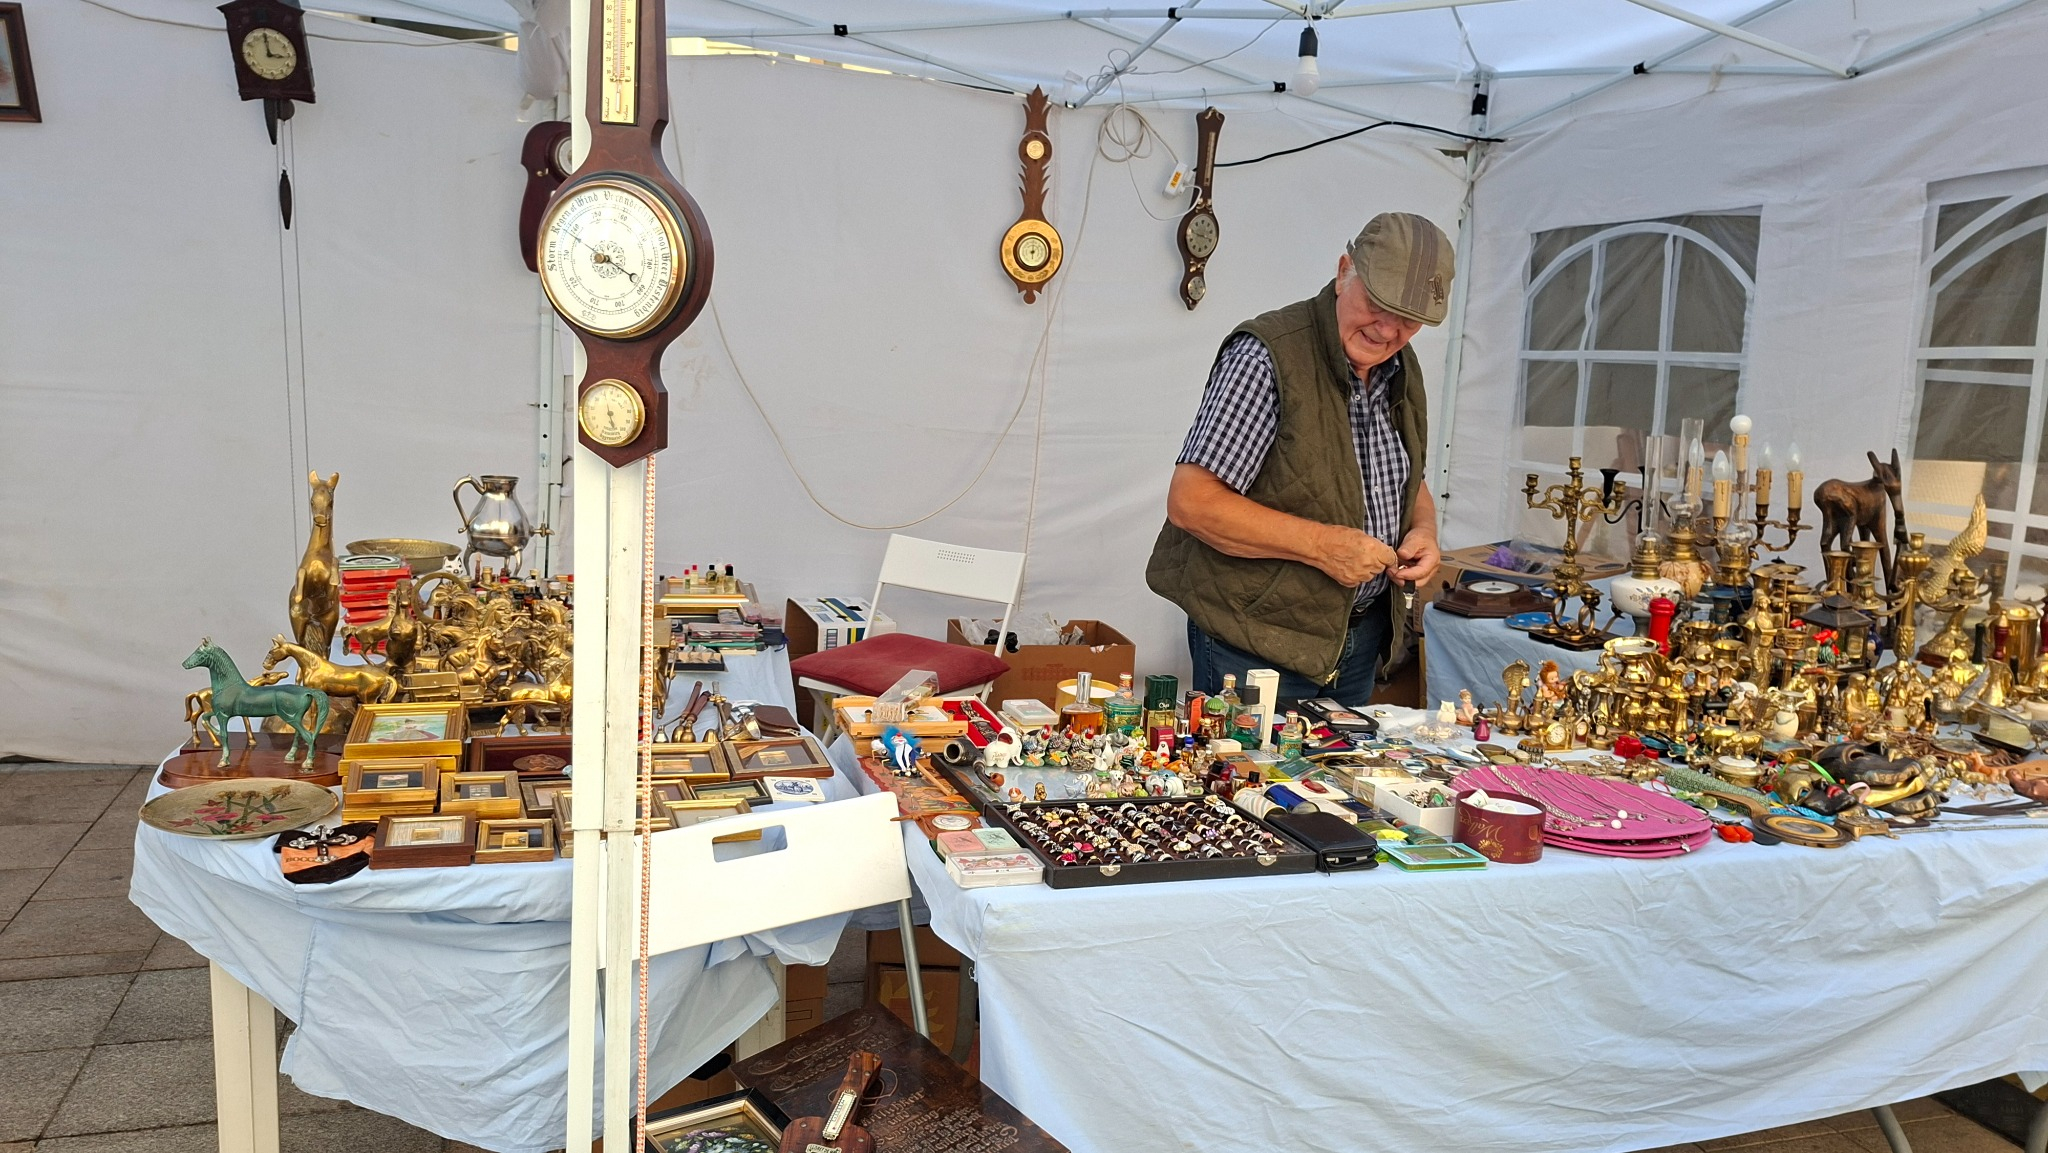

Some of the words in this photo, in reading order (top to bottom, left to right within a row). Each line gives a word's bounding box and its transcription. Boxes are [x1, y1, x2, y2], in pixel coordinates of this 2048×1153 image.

[571, 203, 578, 212] of
[574, 192, 599, 208] Wind
[550, 210, 571, 236] Regen
[653, 226, 668, 251] Mooi
[547, 241, 557, 272] Storm
[661, 252, 671, 277] Weer
[615, 299, 625, 308] 700
[888, 1110, 910, 1125] und
